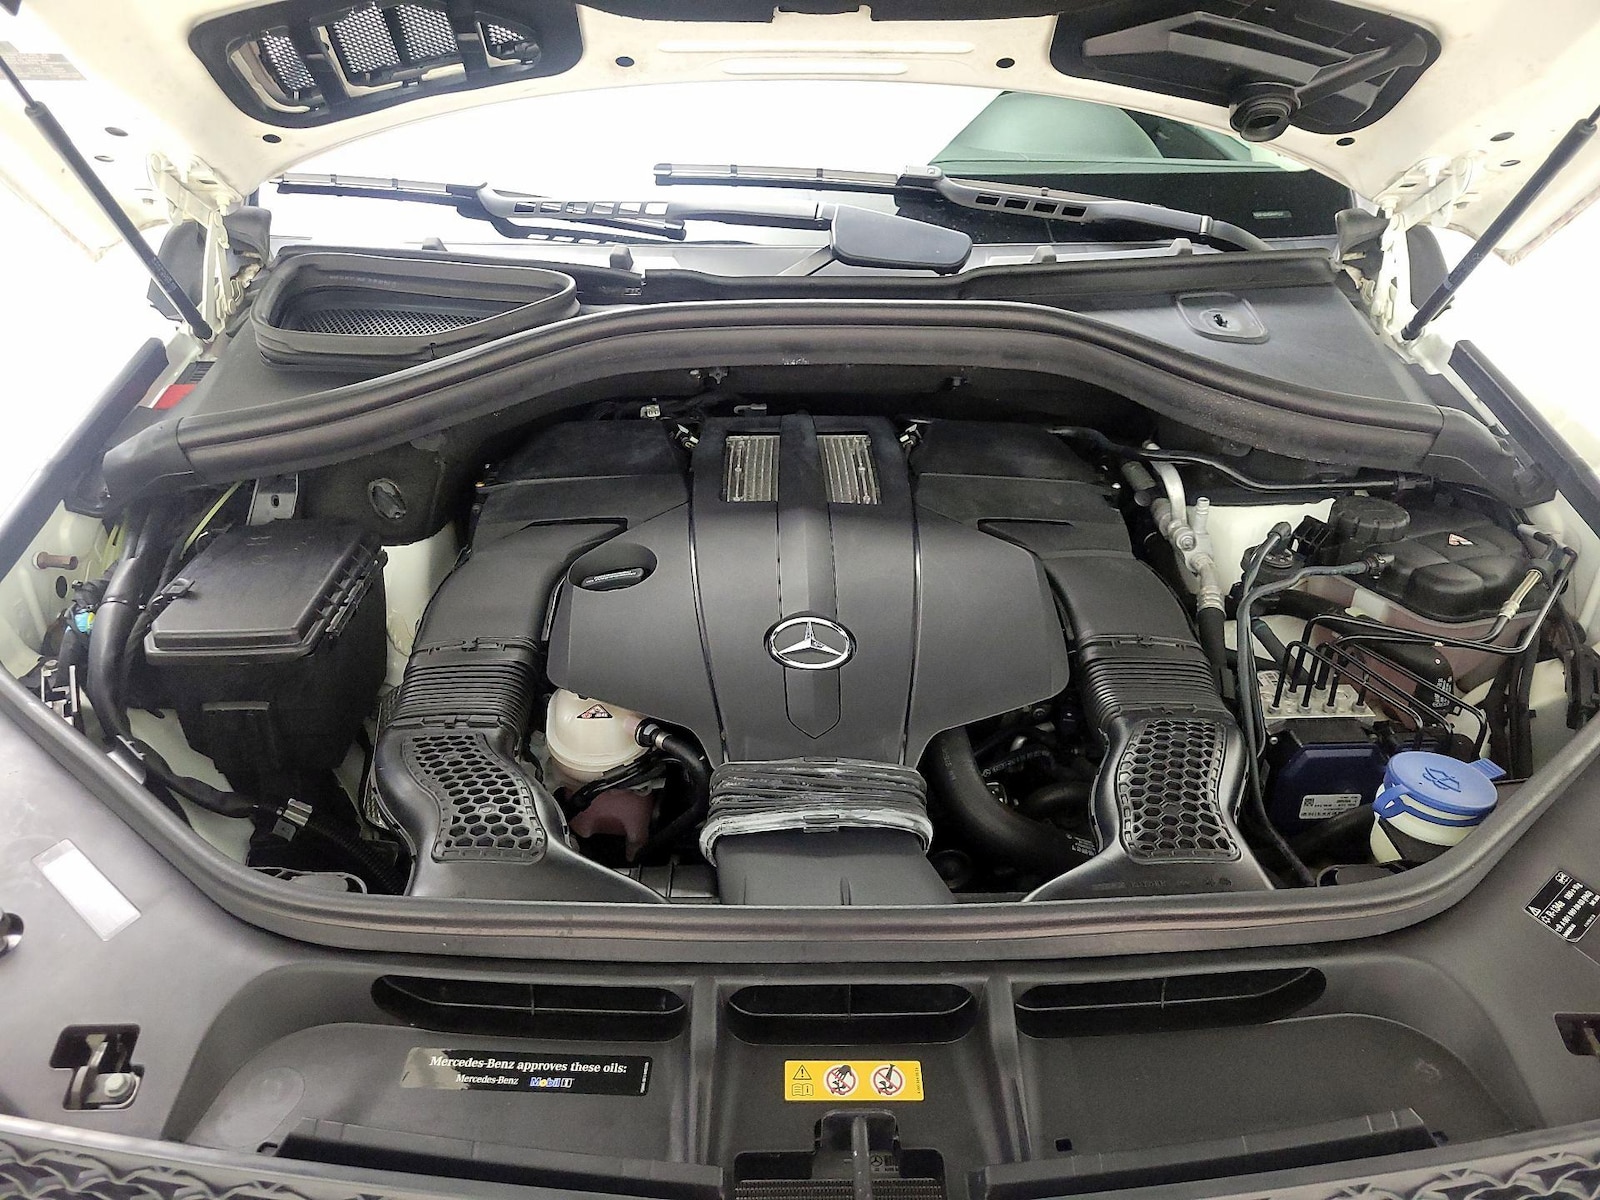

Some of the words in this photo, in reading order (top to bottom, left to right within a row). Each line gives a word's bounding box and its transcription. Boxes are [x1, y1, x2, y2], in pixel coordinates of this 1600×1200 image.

[1546, 901, 1565, 918] R-134a
[429, 1056, 515, 1069] Mercedes-Benz
[517, 1061, 568, 1073] approves
[570, 1061, 601, 1073] these
[603, 1062, 628, 1073] oils:
[455, 1074, 519, 1085] Mercedes-Benz
[529, 1077, 561, 1088] Mobil
